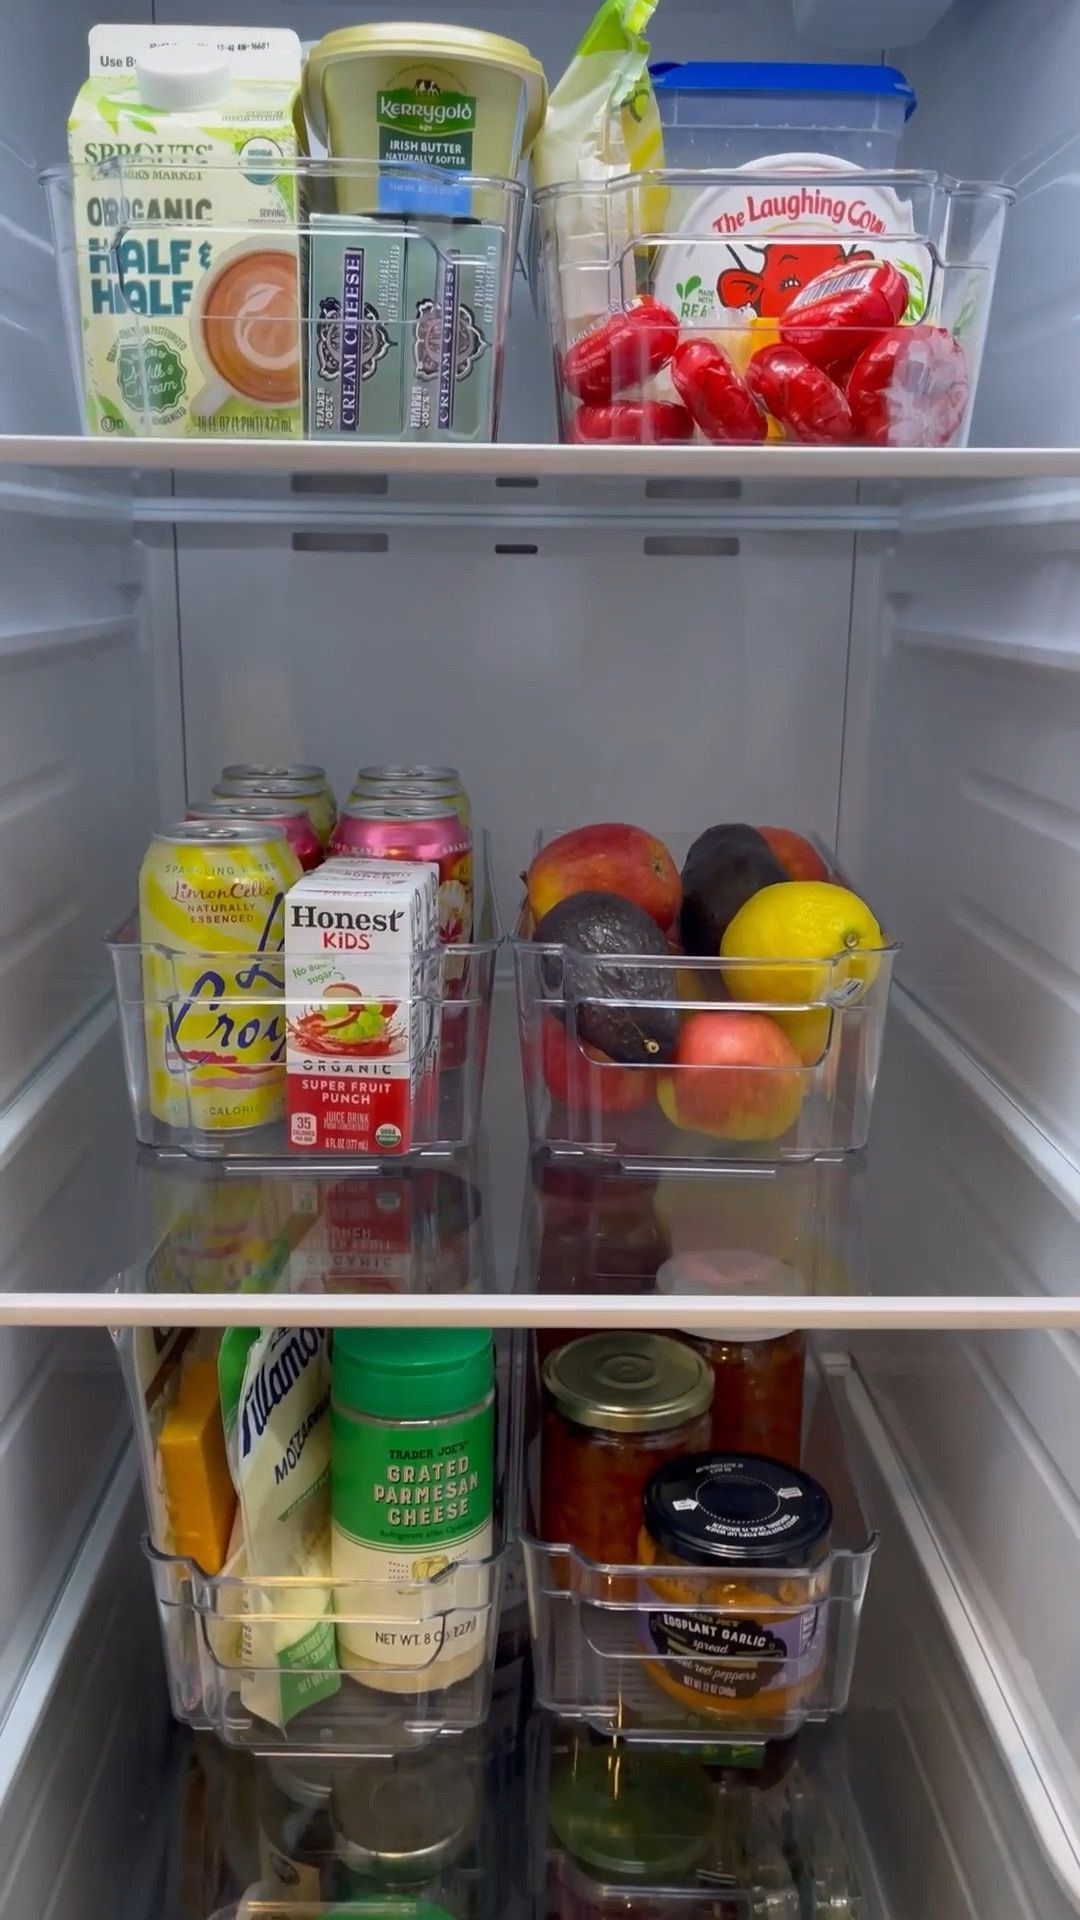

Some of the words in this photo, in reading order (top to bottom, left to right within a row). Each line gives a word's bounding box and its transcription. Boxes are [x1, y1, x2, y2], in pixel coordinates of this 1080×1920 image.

[100, 55, 123, 67] Use
[126, 56, 137, 67] B
[390, 140, 418, 151] IRISH
[421, 142, 462, 154] BUTTER
[386, 152, 433, 163] NATURALLY
[435, 156, 465, 165] SOFTER
[152, 170, 203, 181] MARKET
[712, 211, 745, 233] The
[746, 187, 846, 224] Laughing
[848, 200, 887, 233] Cow
[88, 238, 192, 274] HALF
[198, 241, 213, 271] &
[91, 279, 193, 315] HALF
[344, 258, 360, 344] CHEESE
[444, 263, 456, 344] CHEES
[681, 302, 708, 318] REA
[343, 354, 357, 424] CREAM
[440, 353, 452, 423] CREAM
[316, 387, 325, 428] TRADER
[165, 864, 235, 876] SPALING
[171, 880, 273, 903] LimonCello
[187, 903, 256, 913] NATURALLY
[191, 914, 254, 924] ESSENCED
[291, 905, 404, 932] Honest
[292, 967, 307, 978] No
[307, 969, 334, 986] sugar
[302, 1060, 391, 1075] ORGANIC
[302, 1080, 346, 1091] SUPER
[351, 1082, 391, 1093] FRUIT
[322, 1092, 371, 1105] PUNCH
[297, 1117, 311, 1129] 35
[324, 1111, 345, 1122] JUICE
[347, 1112, 369, 1123] DRINK
[243, 1327, 325, 1458] Tillamo
[389, 1449, 433, 1460] TRADER
[438, 1441, 467, 1456] JOE'S
[387, 1456, 469, 1484] GRATED
[373, 1471, 478, 1505] PARMESAN
[388, 1499, 469, 1527] CHEESE
[375, 1631, 397, 1645] NET
[400, 1634, 421, 1645] WT.
[424, 1633, 431, 1645] 8
[663, 1613, 718, 1637] EGGPLANT
[722, 1629, 766, 1648] GARLIC
[693, 1639, 730, 1654] spread
[694, 1664, 713, 1675] red
[712, 1670, 757, 1683] peppers
